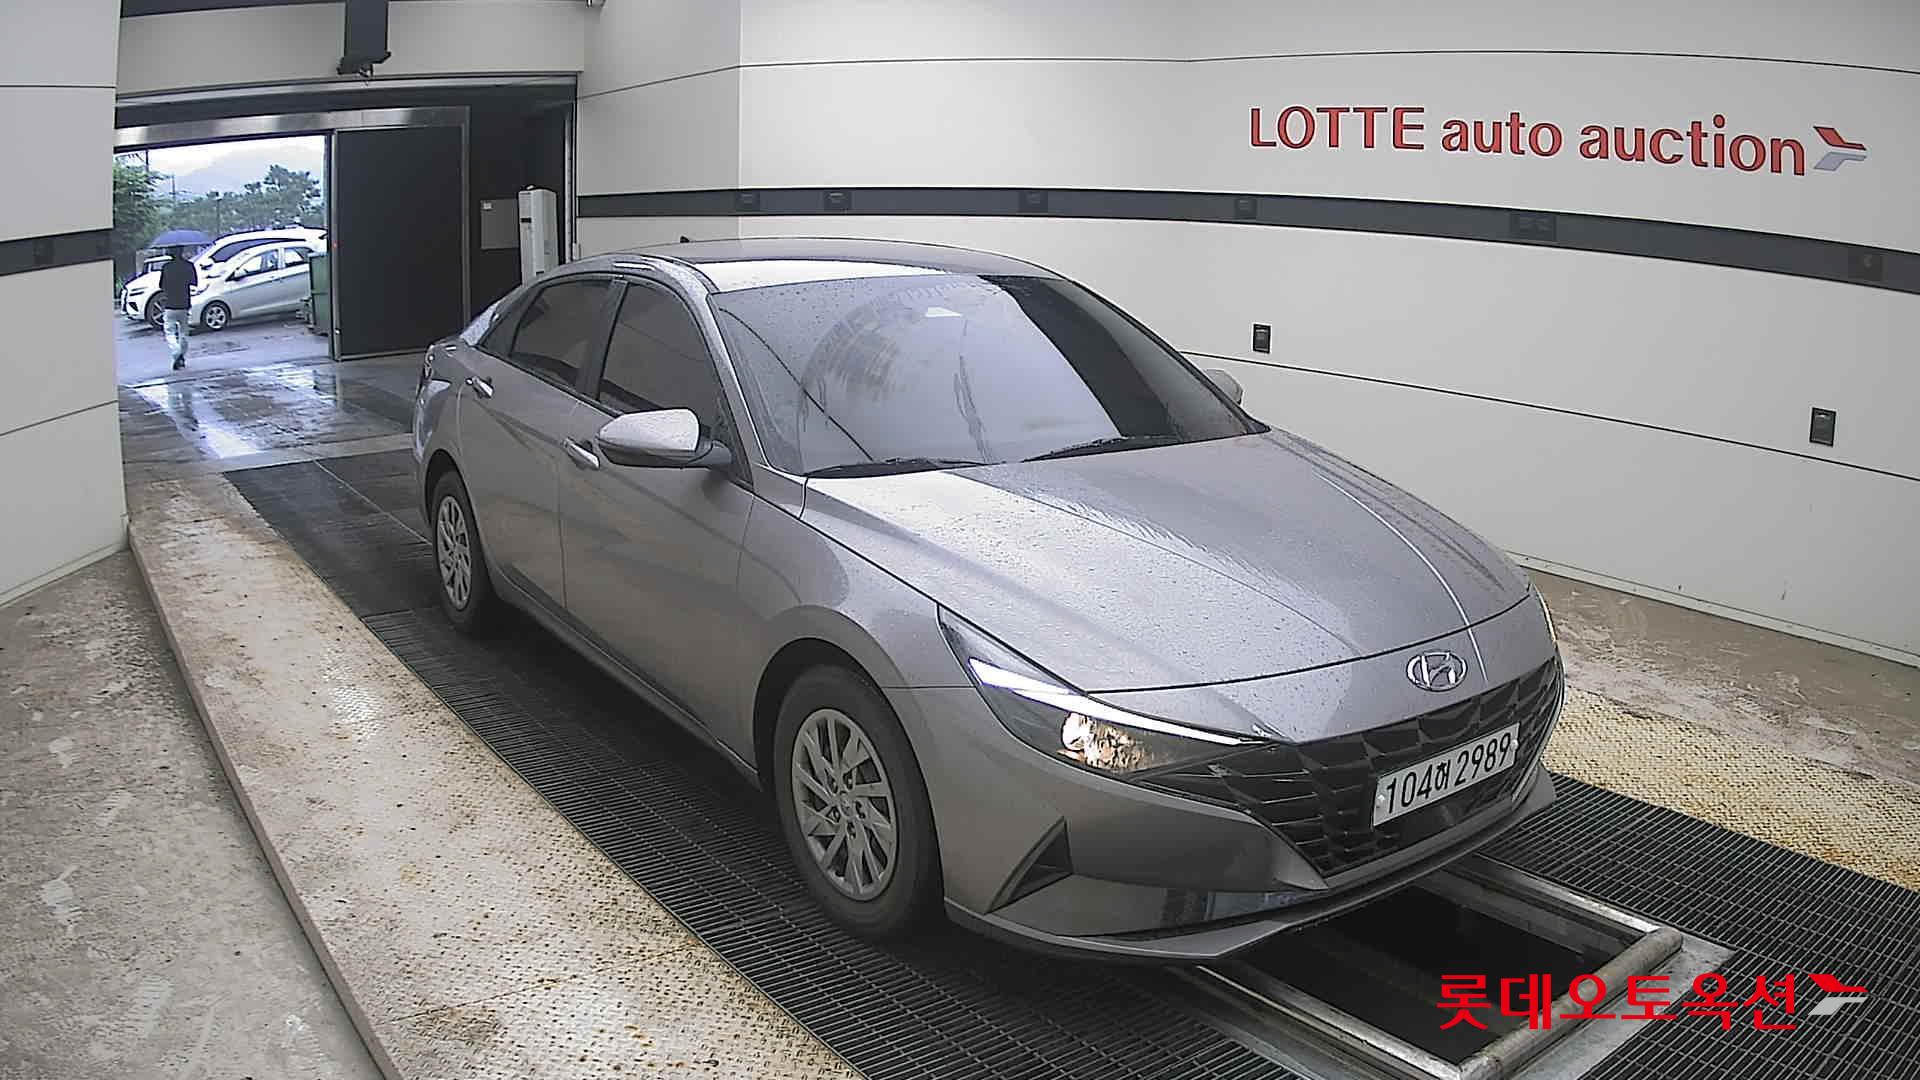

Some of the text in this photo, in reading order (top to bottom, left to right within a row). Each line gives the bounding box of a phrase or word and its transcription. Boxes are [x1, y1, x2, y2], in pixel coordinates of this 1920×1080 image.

[1249, 106, 1806, 176] LOTTE auto auction
